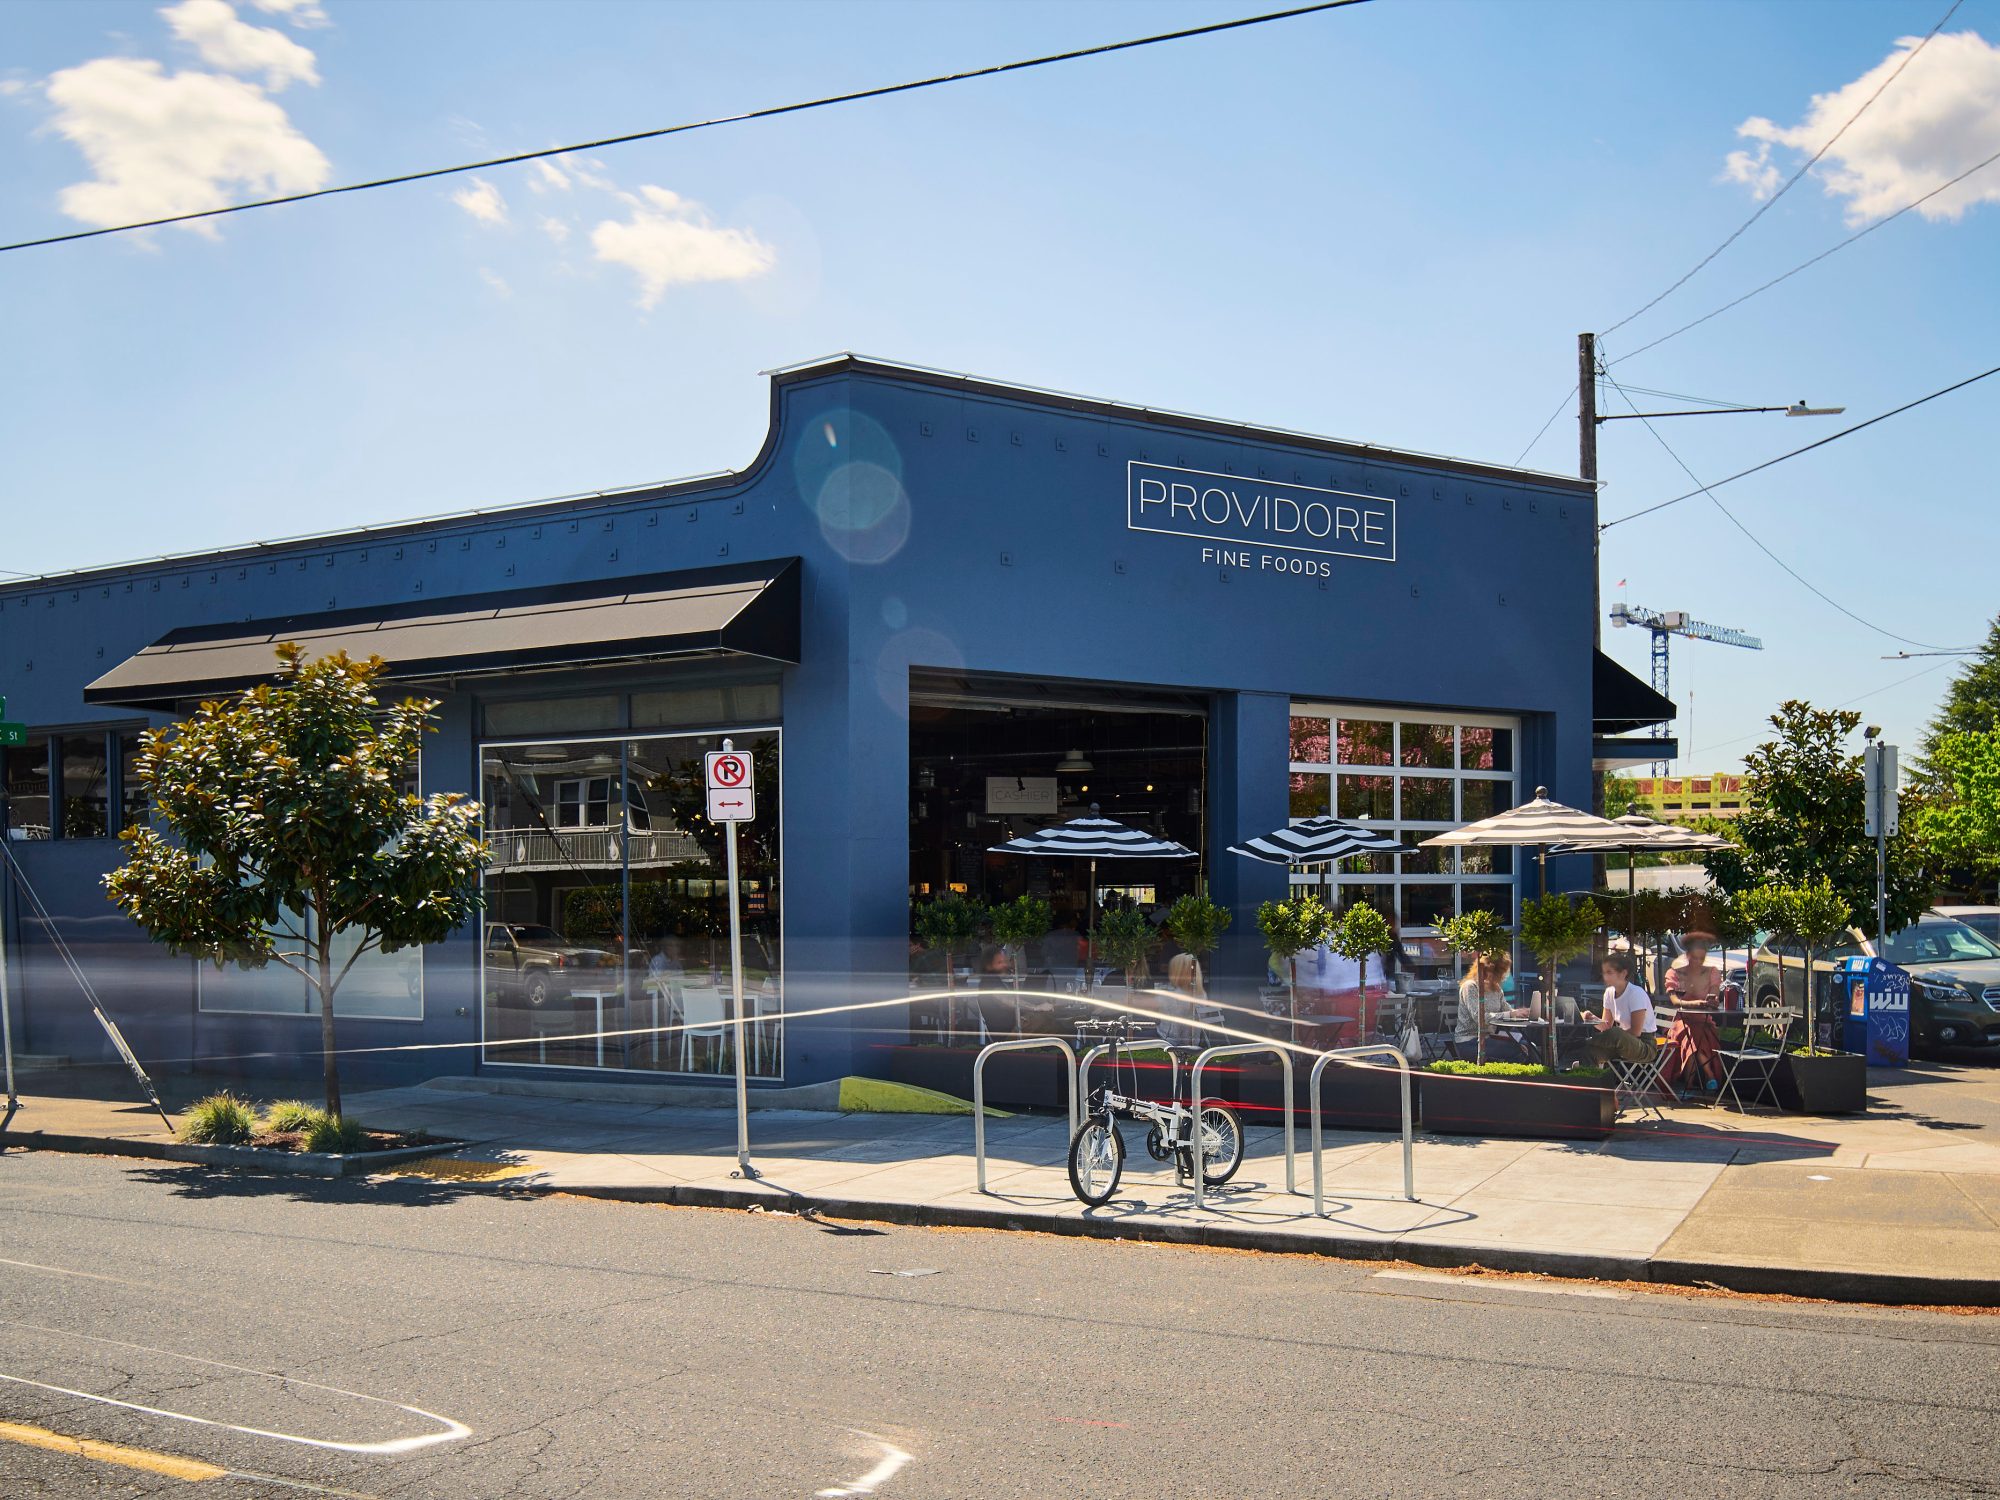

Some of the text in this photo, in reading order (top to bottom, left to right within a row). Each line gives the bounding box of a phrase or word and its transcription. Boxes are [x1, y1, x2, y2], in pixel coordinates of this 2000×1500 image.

[1140, 478, 1386, 545] PROVIDORE
[1202, 548, 1331, 577] FINE FOODS
[724, 761, 739, 780] P
[995, 790, 1050, 801] CASHIER
